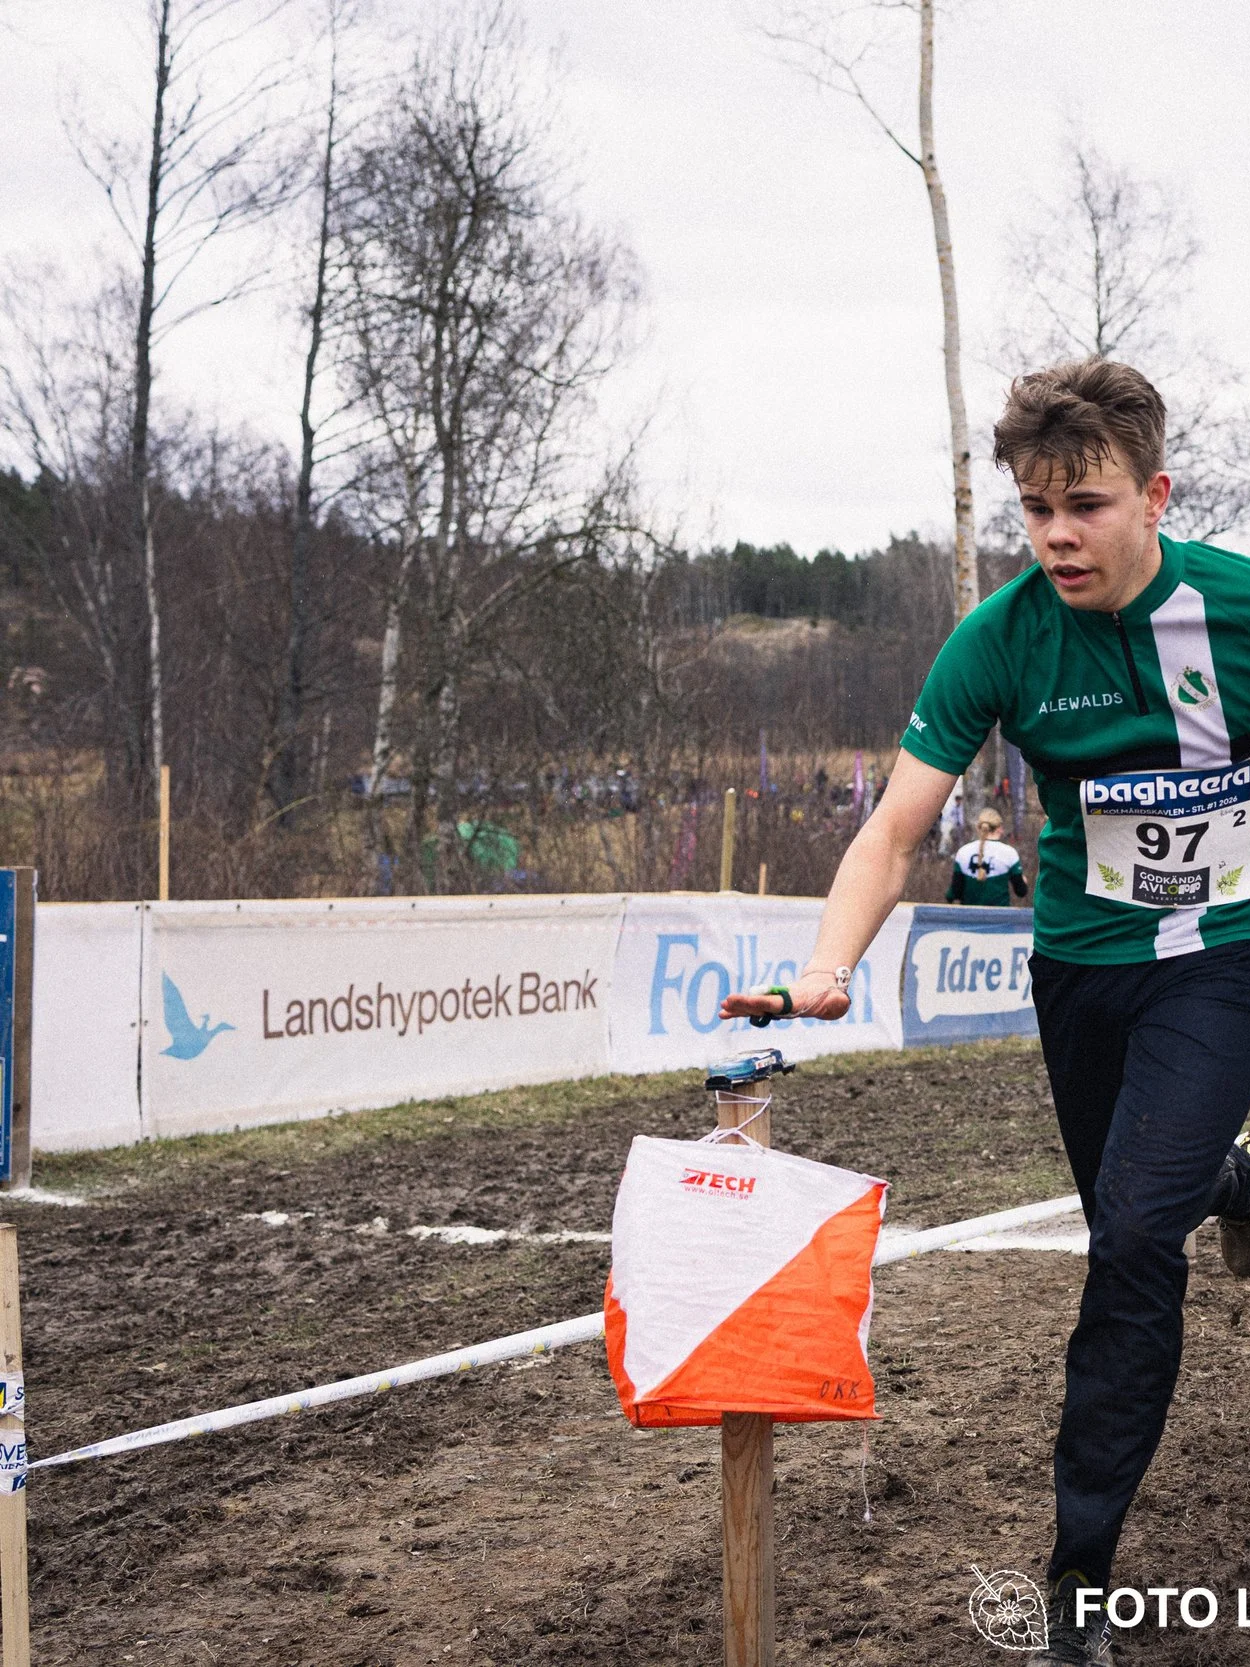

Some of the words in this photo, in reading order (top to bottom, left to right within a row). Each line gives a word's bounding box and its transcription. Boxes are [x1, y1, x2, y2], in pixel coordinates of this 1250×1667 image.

[1039, 692, 1123, 714] ALEWALDS
[1087, 766, 1250, 806] bagheera
[1192, 805, 1205, 813] STL
[1207, 801, 1217, 810] #1
[1219, 796, 1238, 807] 2026
[1233, 809, 1246, 827] 2
[1136, 821, 1209, 863] 97
[1139, 880, 1201, 895] AVLOPP
[1140, 871, 1202, 884] GODKÄNDA
[936, 944, 1002, 992] Idre
[264, 974, 512, 1039] Landshypotek
[519, 969, 598, 1014] Bank
